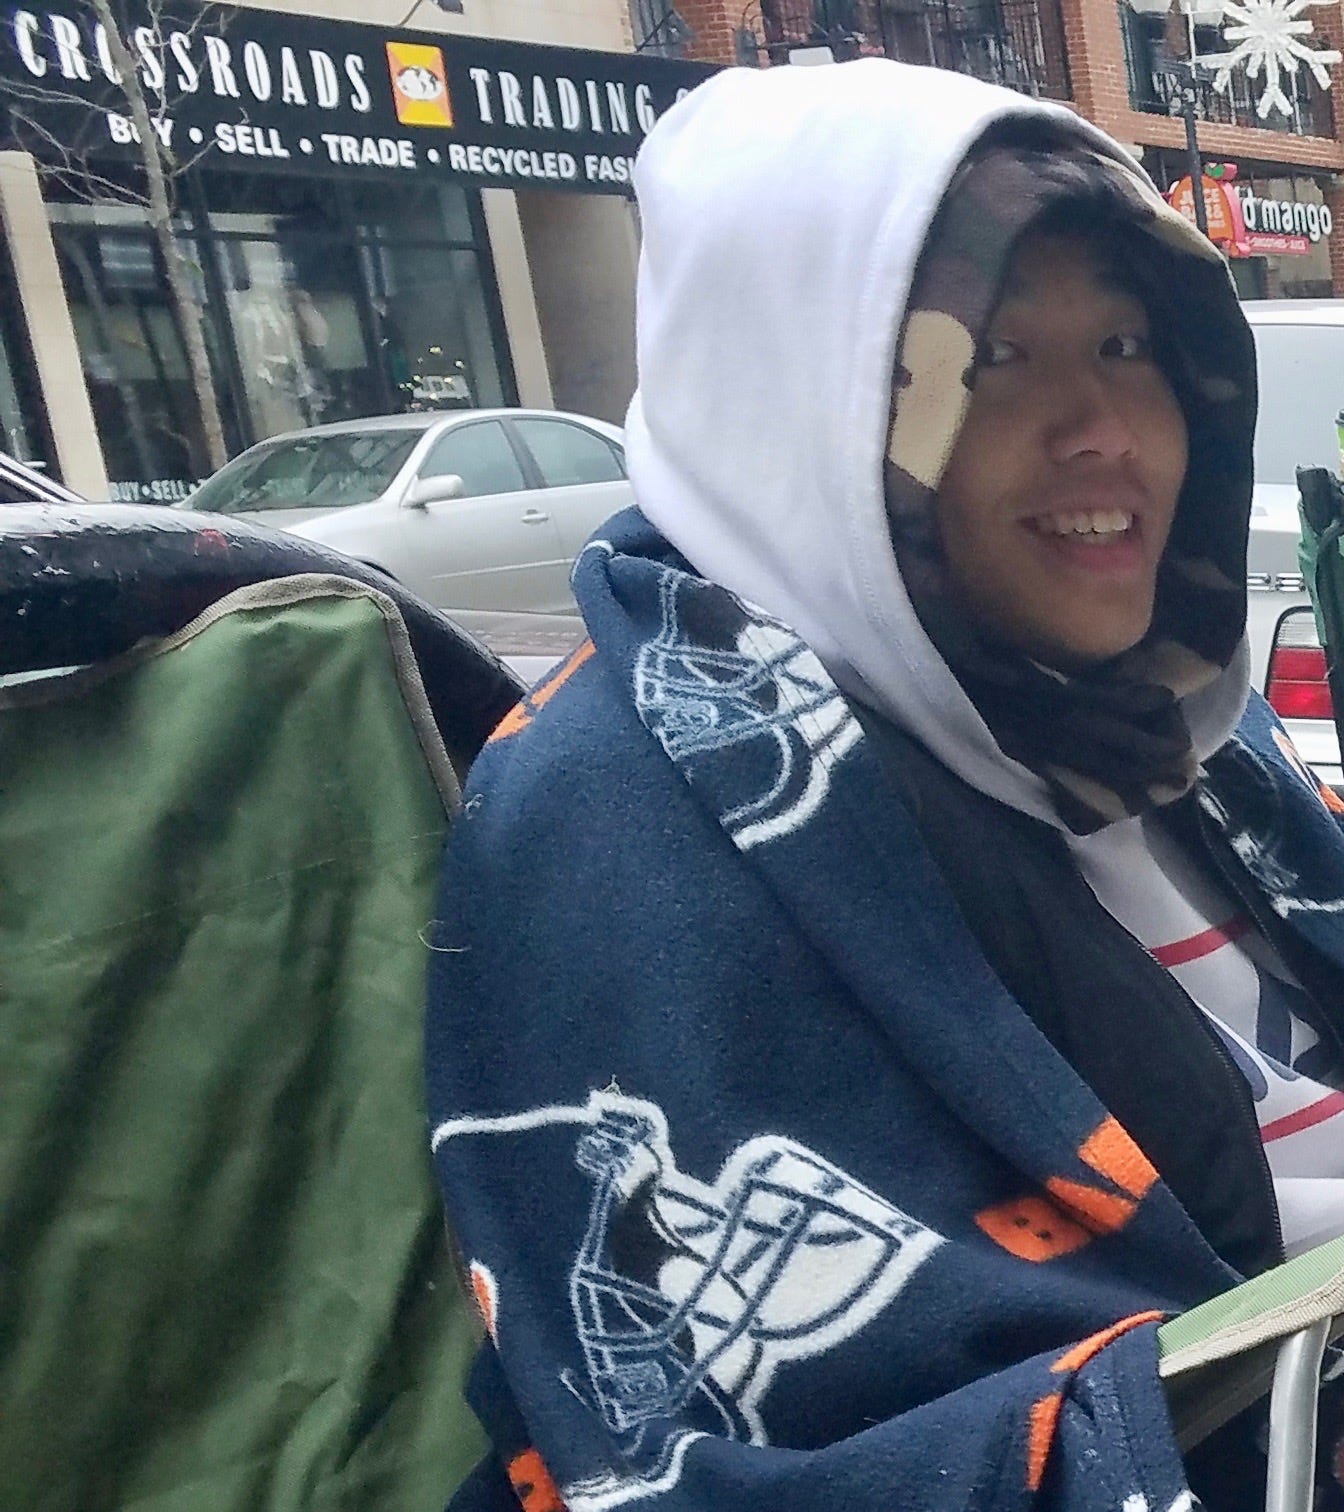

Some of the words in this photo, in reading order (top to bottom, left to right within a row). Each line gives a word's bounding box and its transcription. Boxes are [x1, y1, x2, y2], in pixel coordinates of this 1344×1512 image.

[14, 10, 372, 112] CROSSROADS
[469, 67, 657, 136] TRADING
[214, 122, 290, 158] SELL
[321, 133, 417, 168] TRADE
[449, 143, 577, 179] RECYCLED
[1261, 198, 1333, 242] mango
[151, 480, 190, 500] SELL
